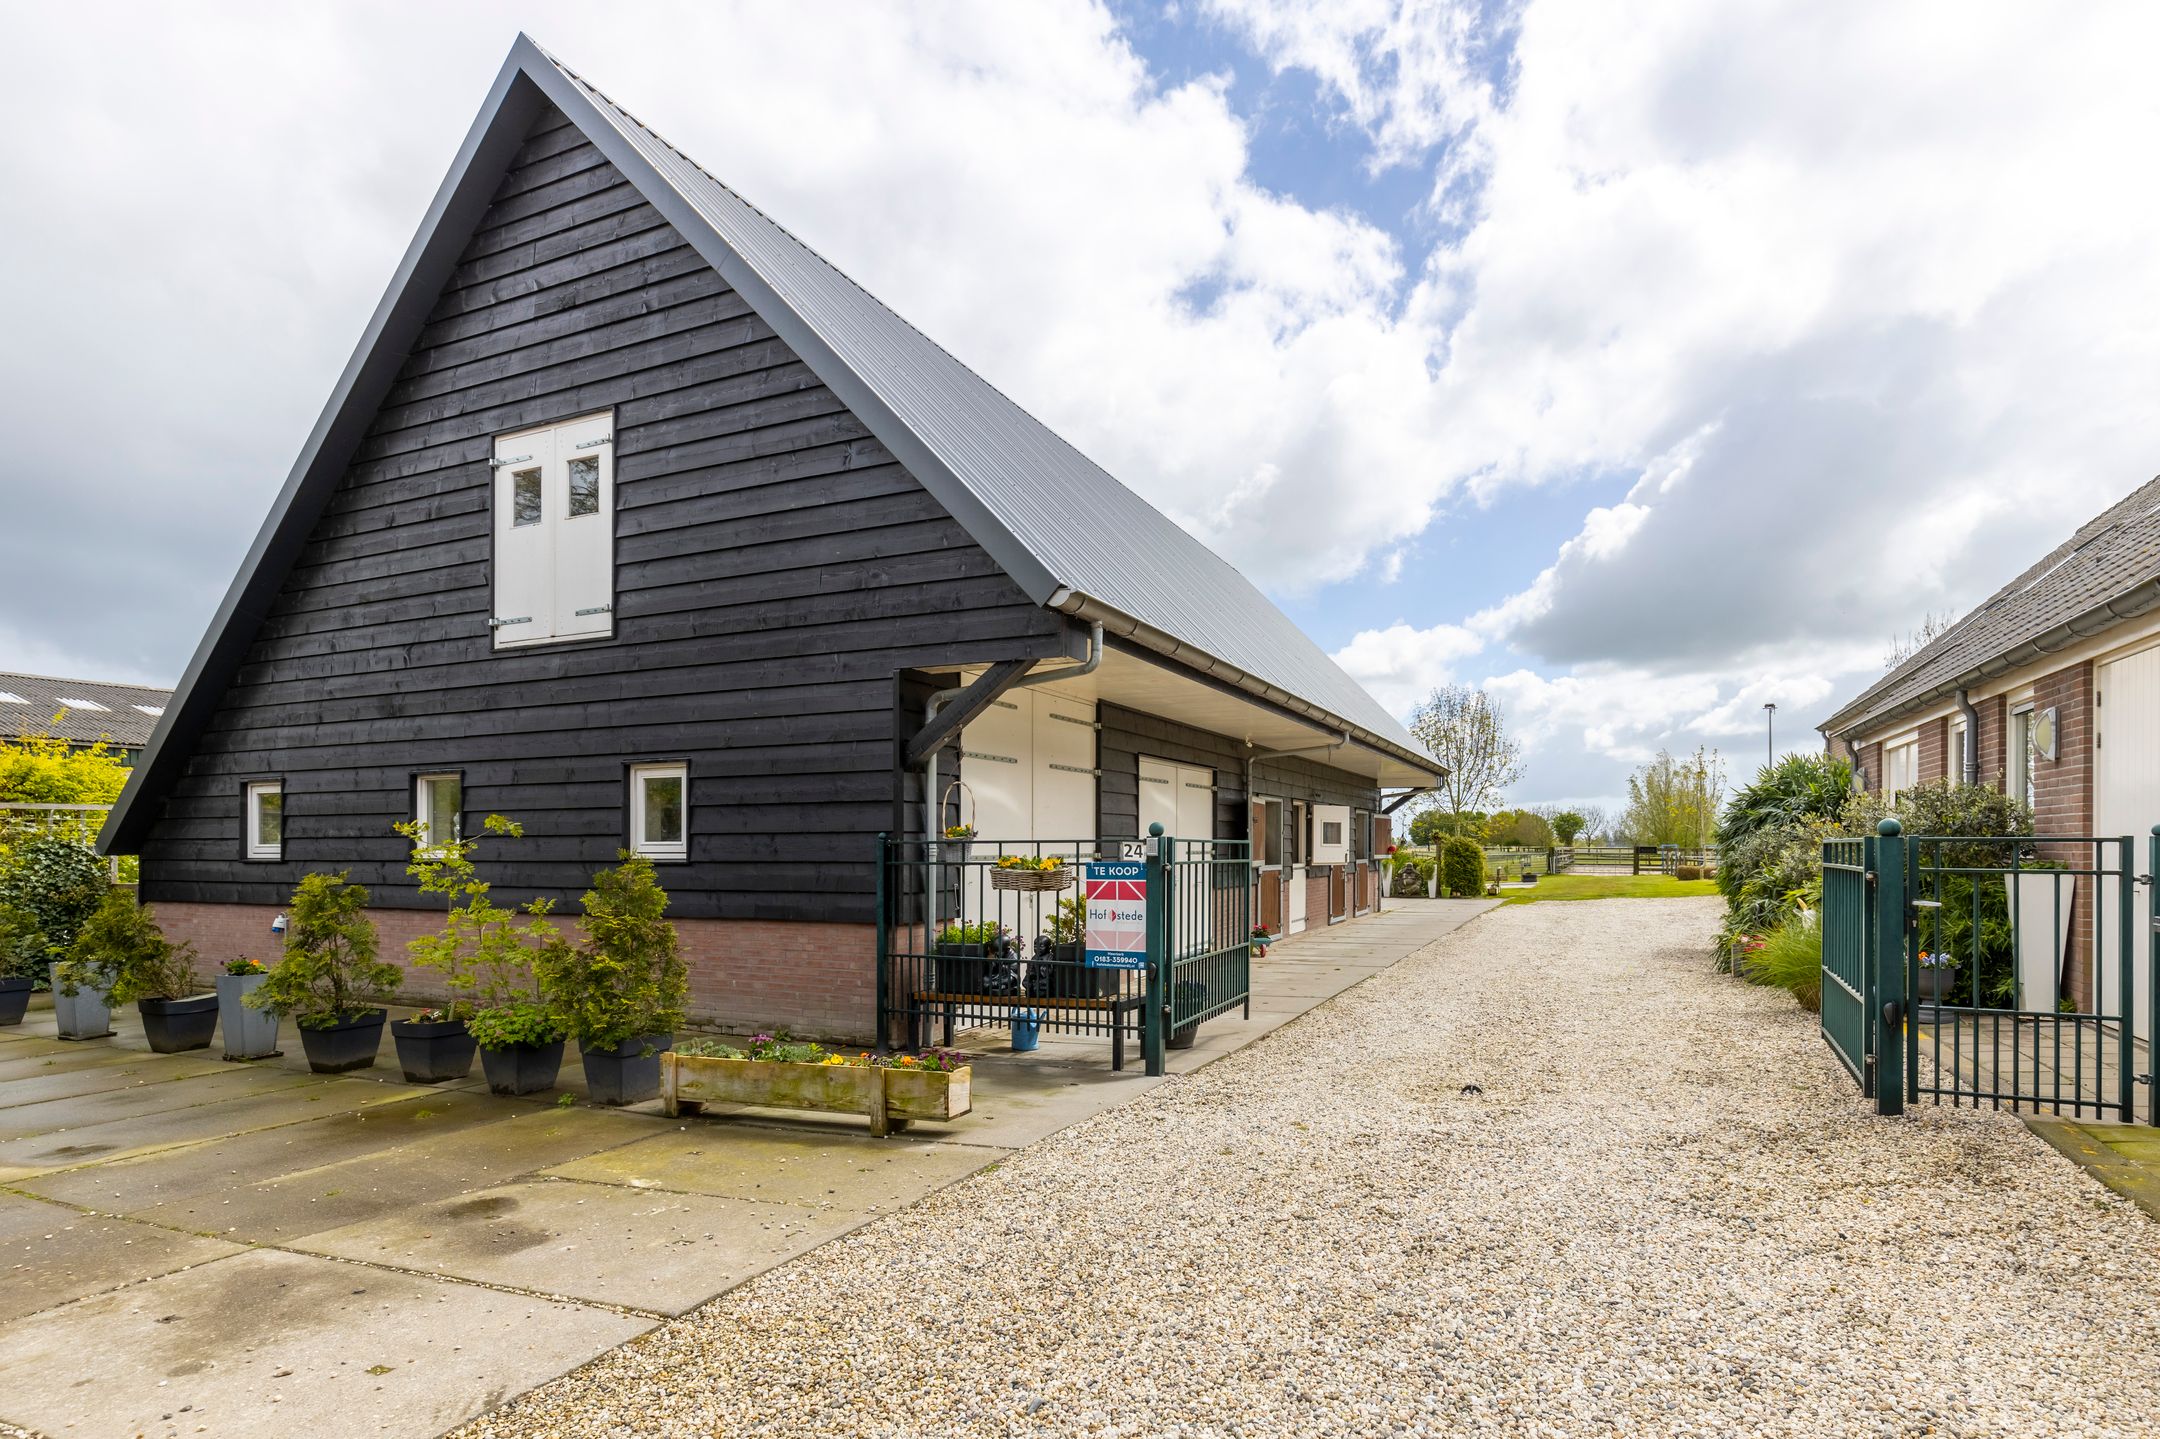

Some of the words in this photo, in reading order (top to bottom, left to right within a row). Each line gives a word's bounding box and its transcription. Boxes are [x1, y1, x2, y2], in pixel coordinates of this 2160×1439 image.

[1124, 844, 1143, 858] 24
[1094, 867, 1106, 875] TE
[1109, 867, 1139, 876] KOOP
